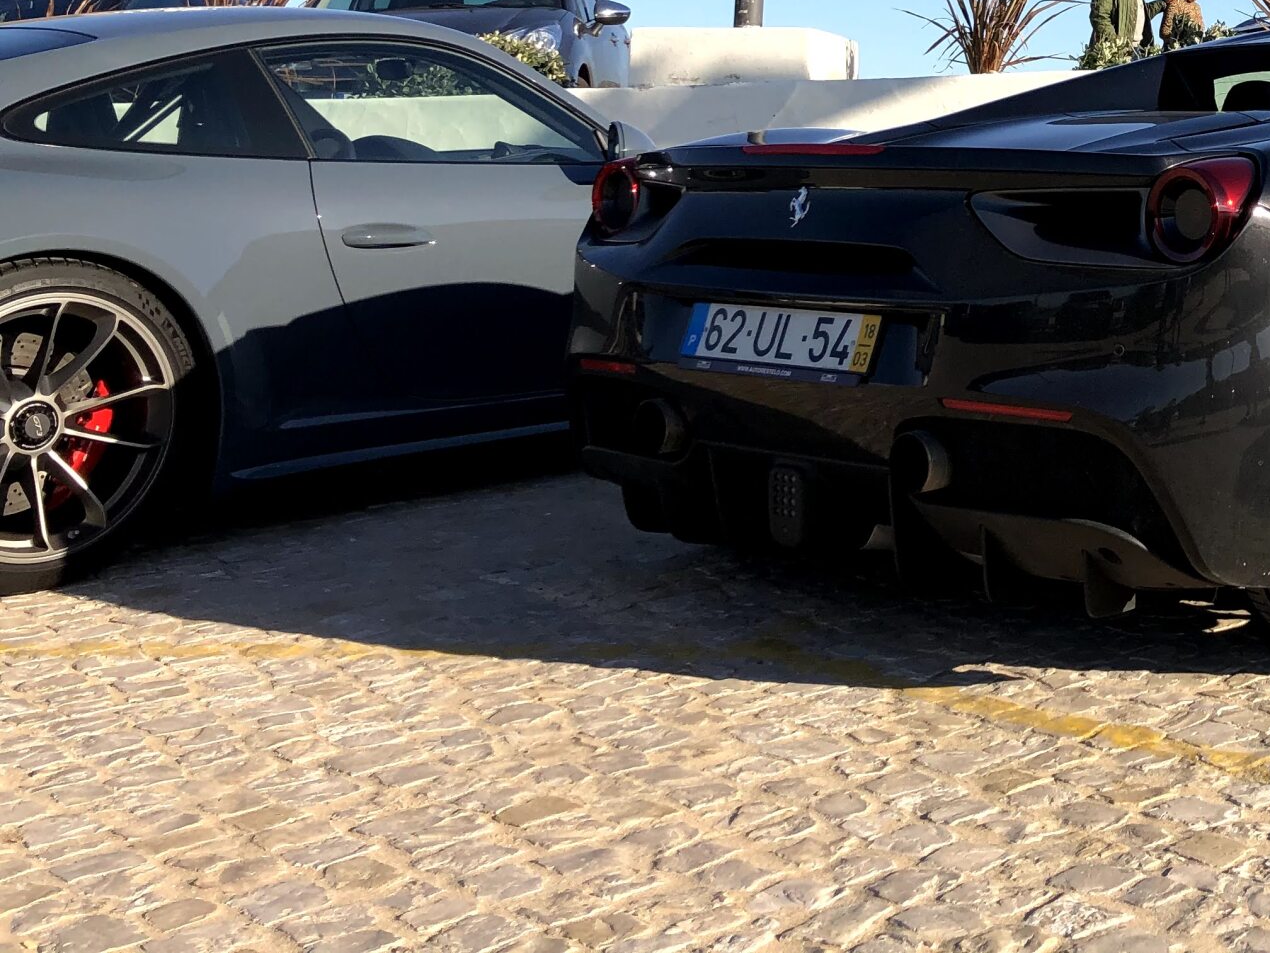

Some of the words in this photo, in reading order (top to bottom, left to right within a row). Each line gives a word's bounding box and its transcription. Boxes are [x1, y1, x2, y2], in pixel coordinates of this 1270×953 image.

[864, 323, 877, 339] 18
[687, 334, 697, 346] P
[852, 351, 869, 367] 03
